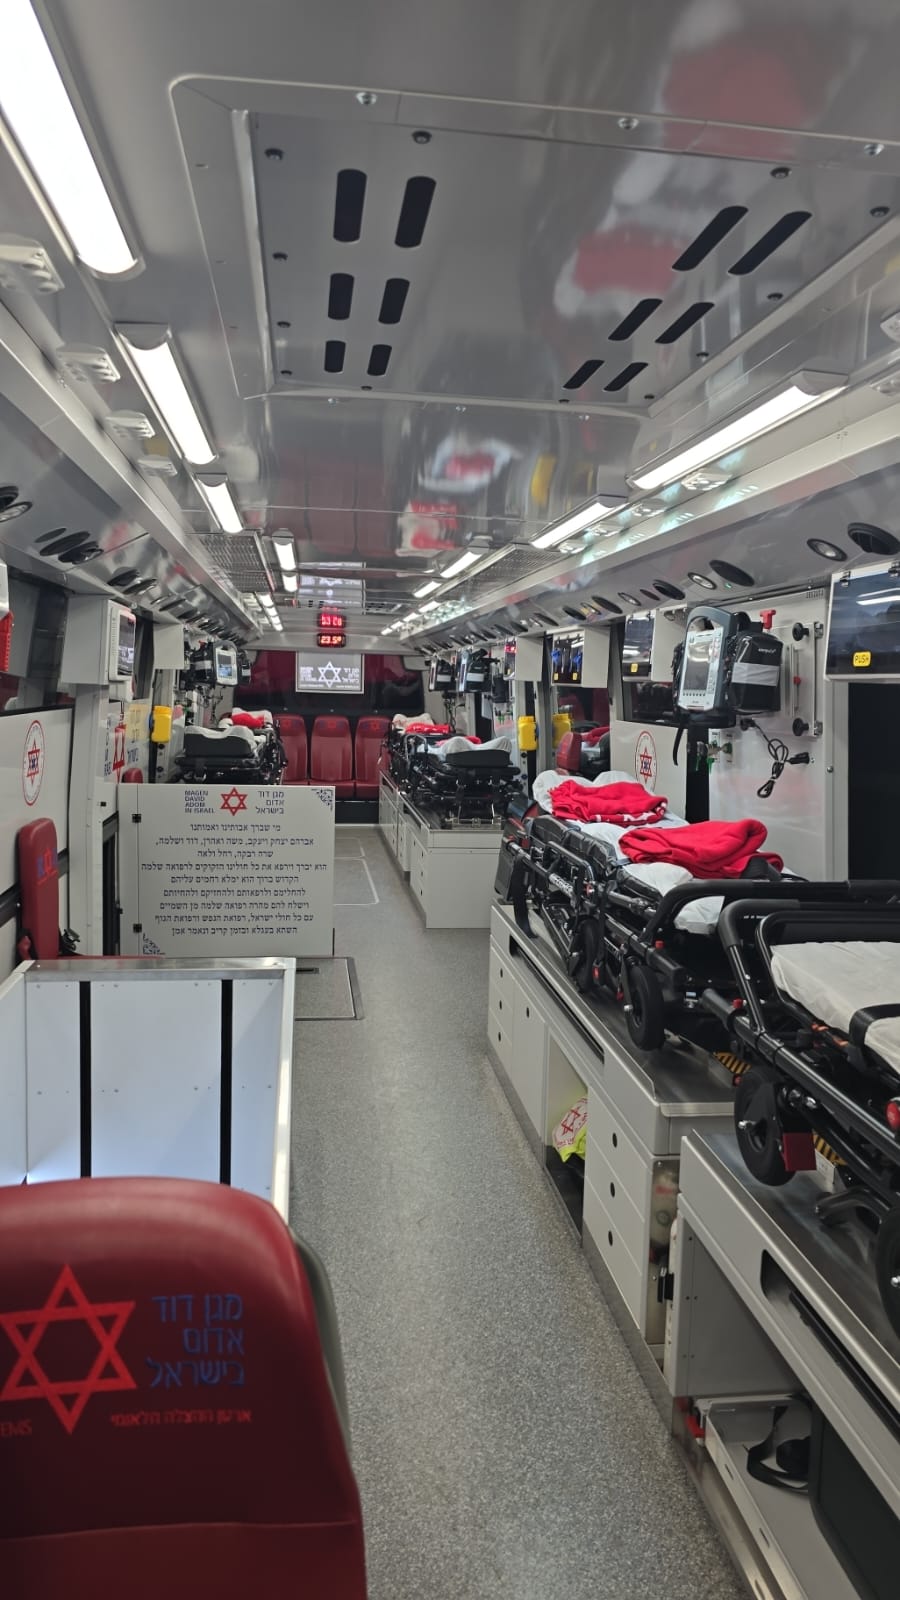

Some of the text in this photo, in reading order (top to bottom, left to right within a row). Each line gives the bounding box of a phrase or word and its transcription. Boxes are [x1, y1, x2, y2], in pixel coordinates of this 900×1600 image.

[258, 790, 285, 799] מגן דוד
[256, 806, 285, 815] בישראל
[250, 824, 271, 833] שברך
[270, 838, 289, 847] יצחק
[142, 862, 164, 870] שלמה
[165, 862, 194, 871] לרפואה
[195, 864, 225, 872] הזקוקים
[251, 862, 260, 870] כל
[296, 864, 313, 872] יברך
[171, 875, 194, 883] עליהם
[222, 875, 240, 883] ימלא
[241, 876, 255, 884] הוא
[256, 876, 274, 885] ברוך
[275, 876, 300, 885] הקדוש
[190, 903, 199, 911] מן
[201, 901, 223, 909] שלמה
[271, 901, 286, 909] להם
[288, 901, 310, 909] וישלח
[172, 928, 186, 936] אמן
[211, 928, 229, 936] קריב
[152, 1292, 244, 1327] מגן דוד
[183, 1327, 245, 1356] אדום
[145, 1357, 245, 1389] בישראל
